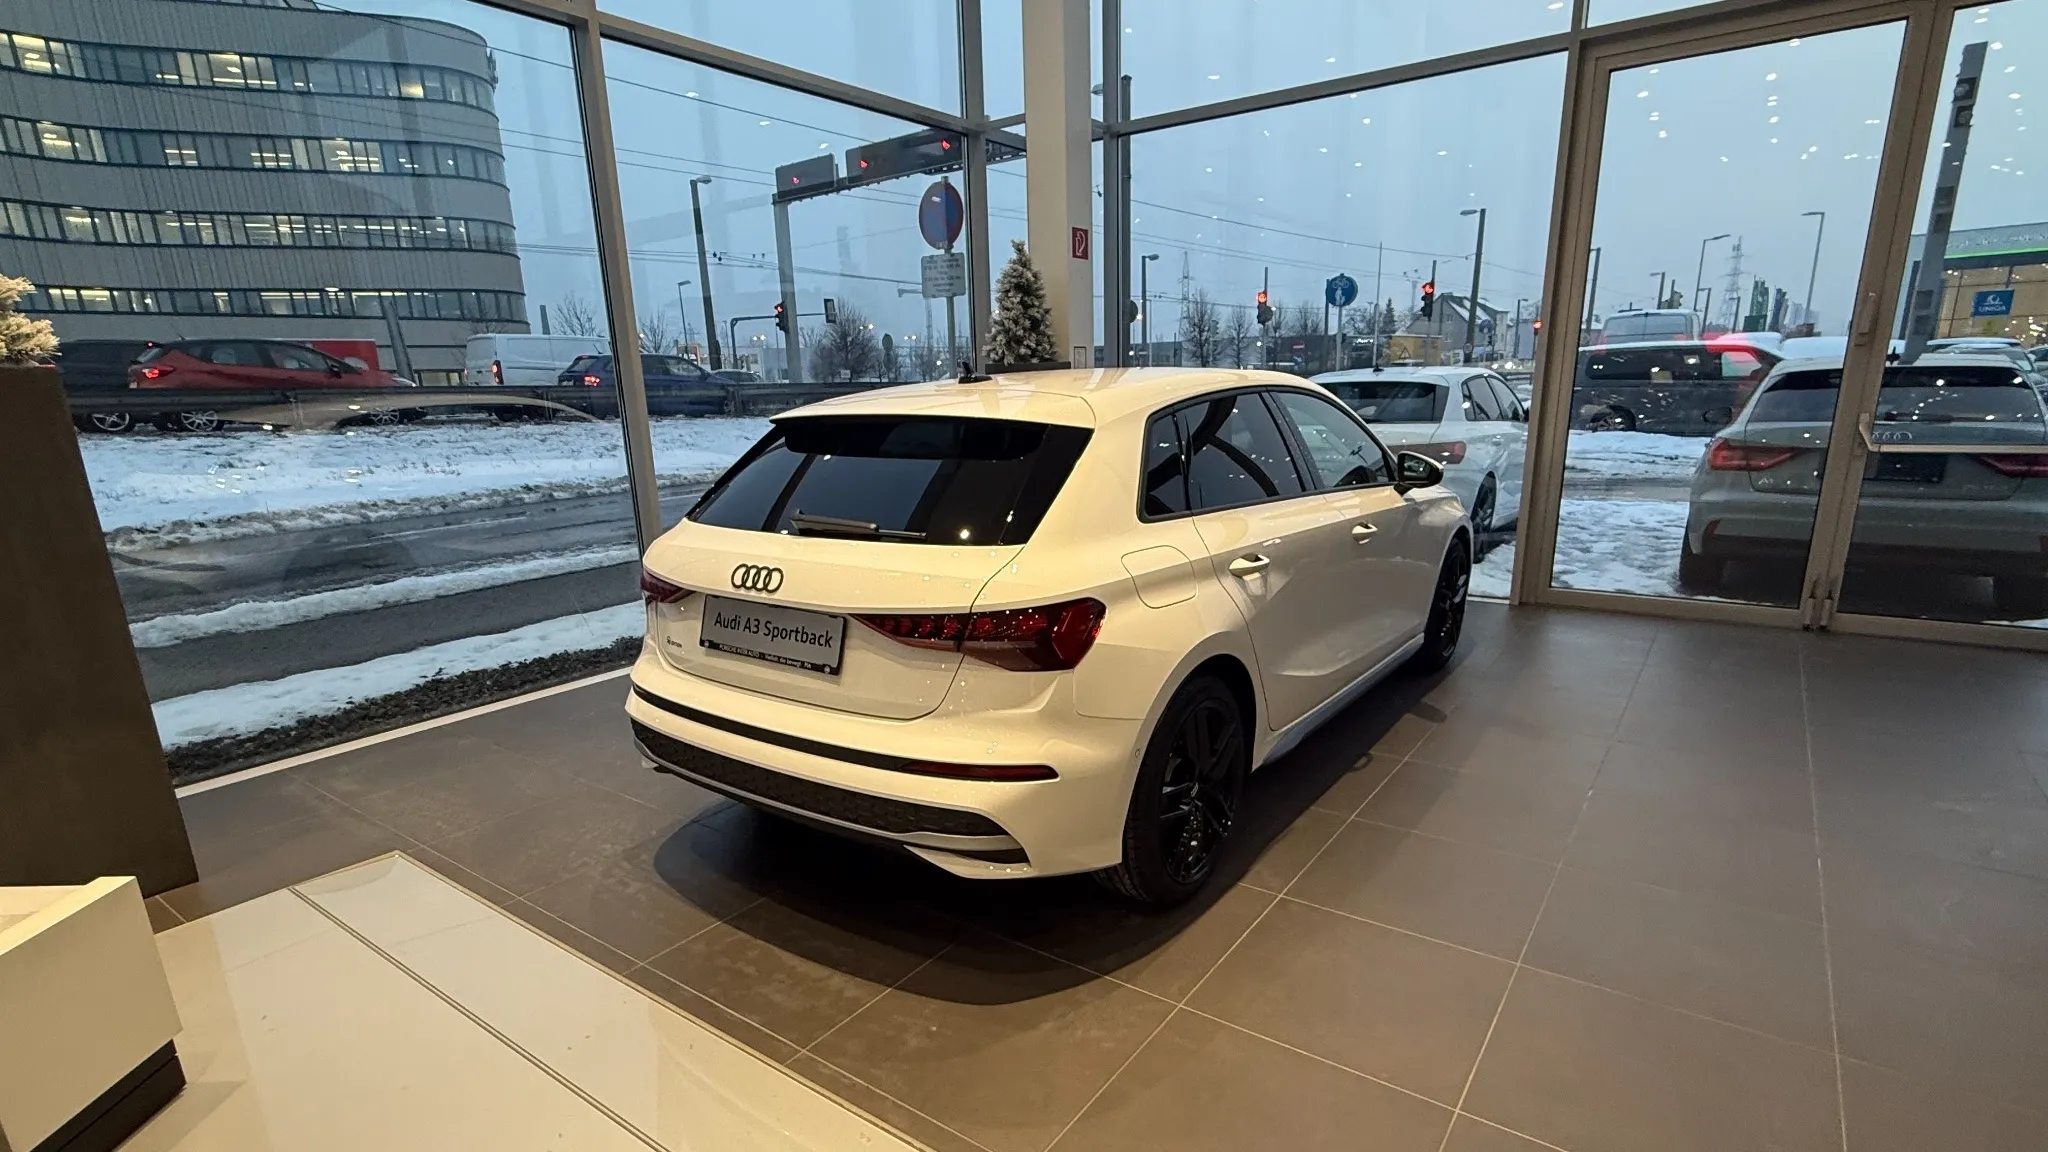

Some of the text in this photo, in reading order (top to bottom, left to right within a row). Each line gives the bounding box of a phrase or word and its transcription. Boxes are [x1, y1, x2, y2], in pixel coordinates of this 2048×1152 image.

[714, 611, 833, 648] Audi A3 Sportback
